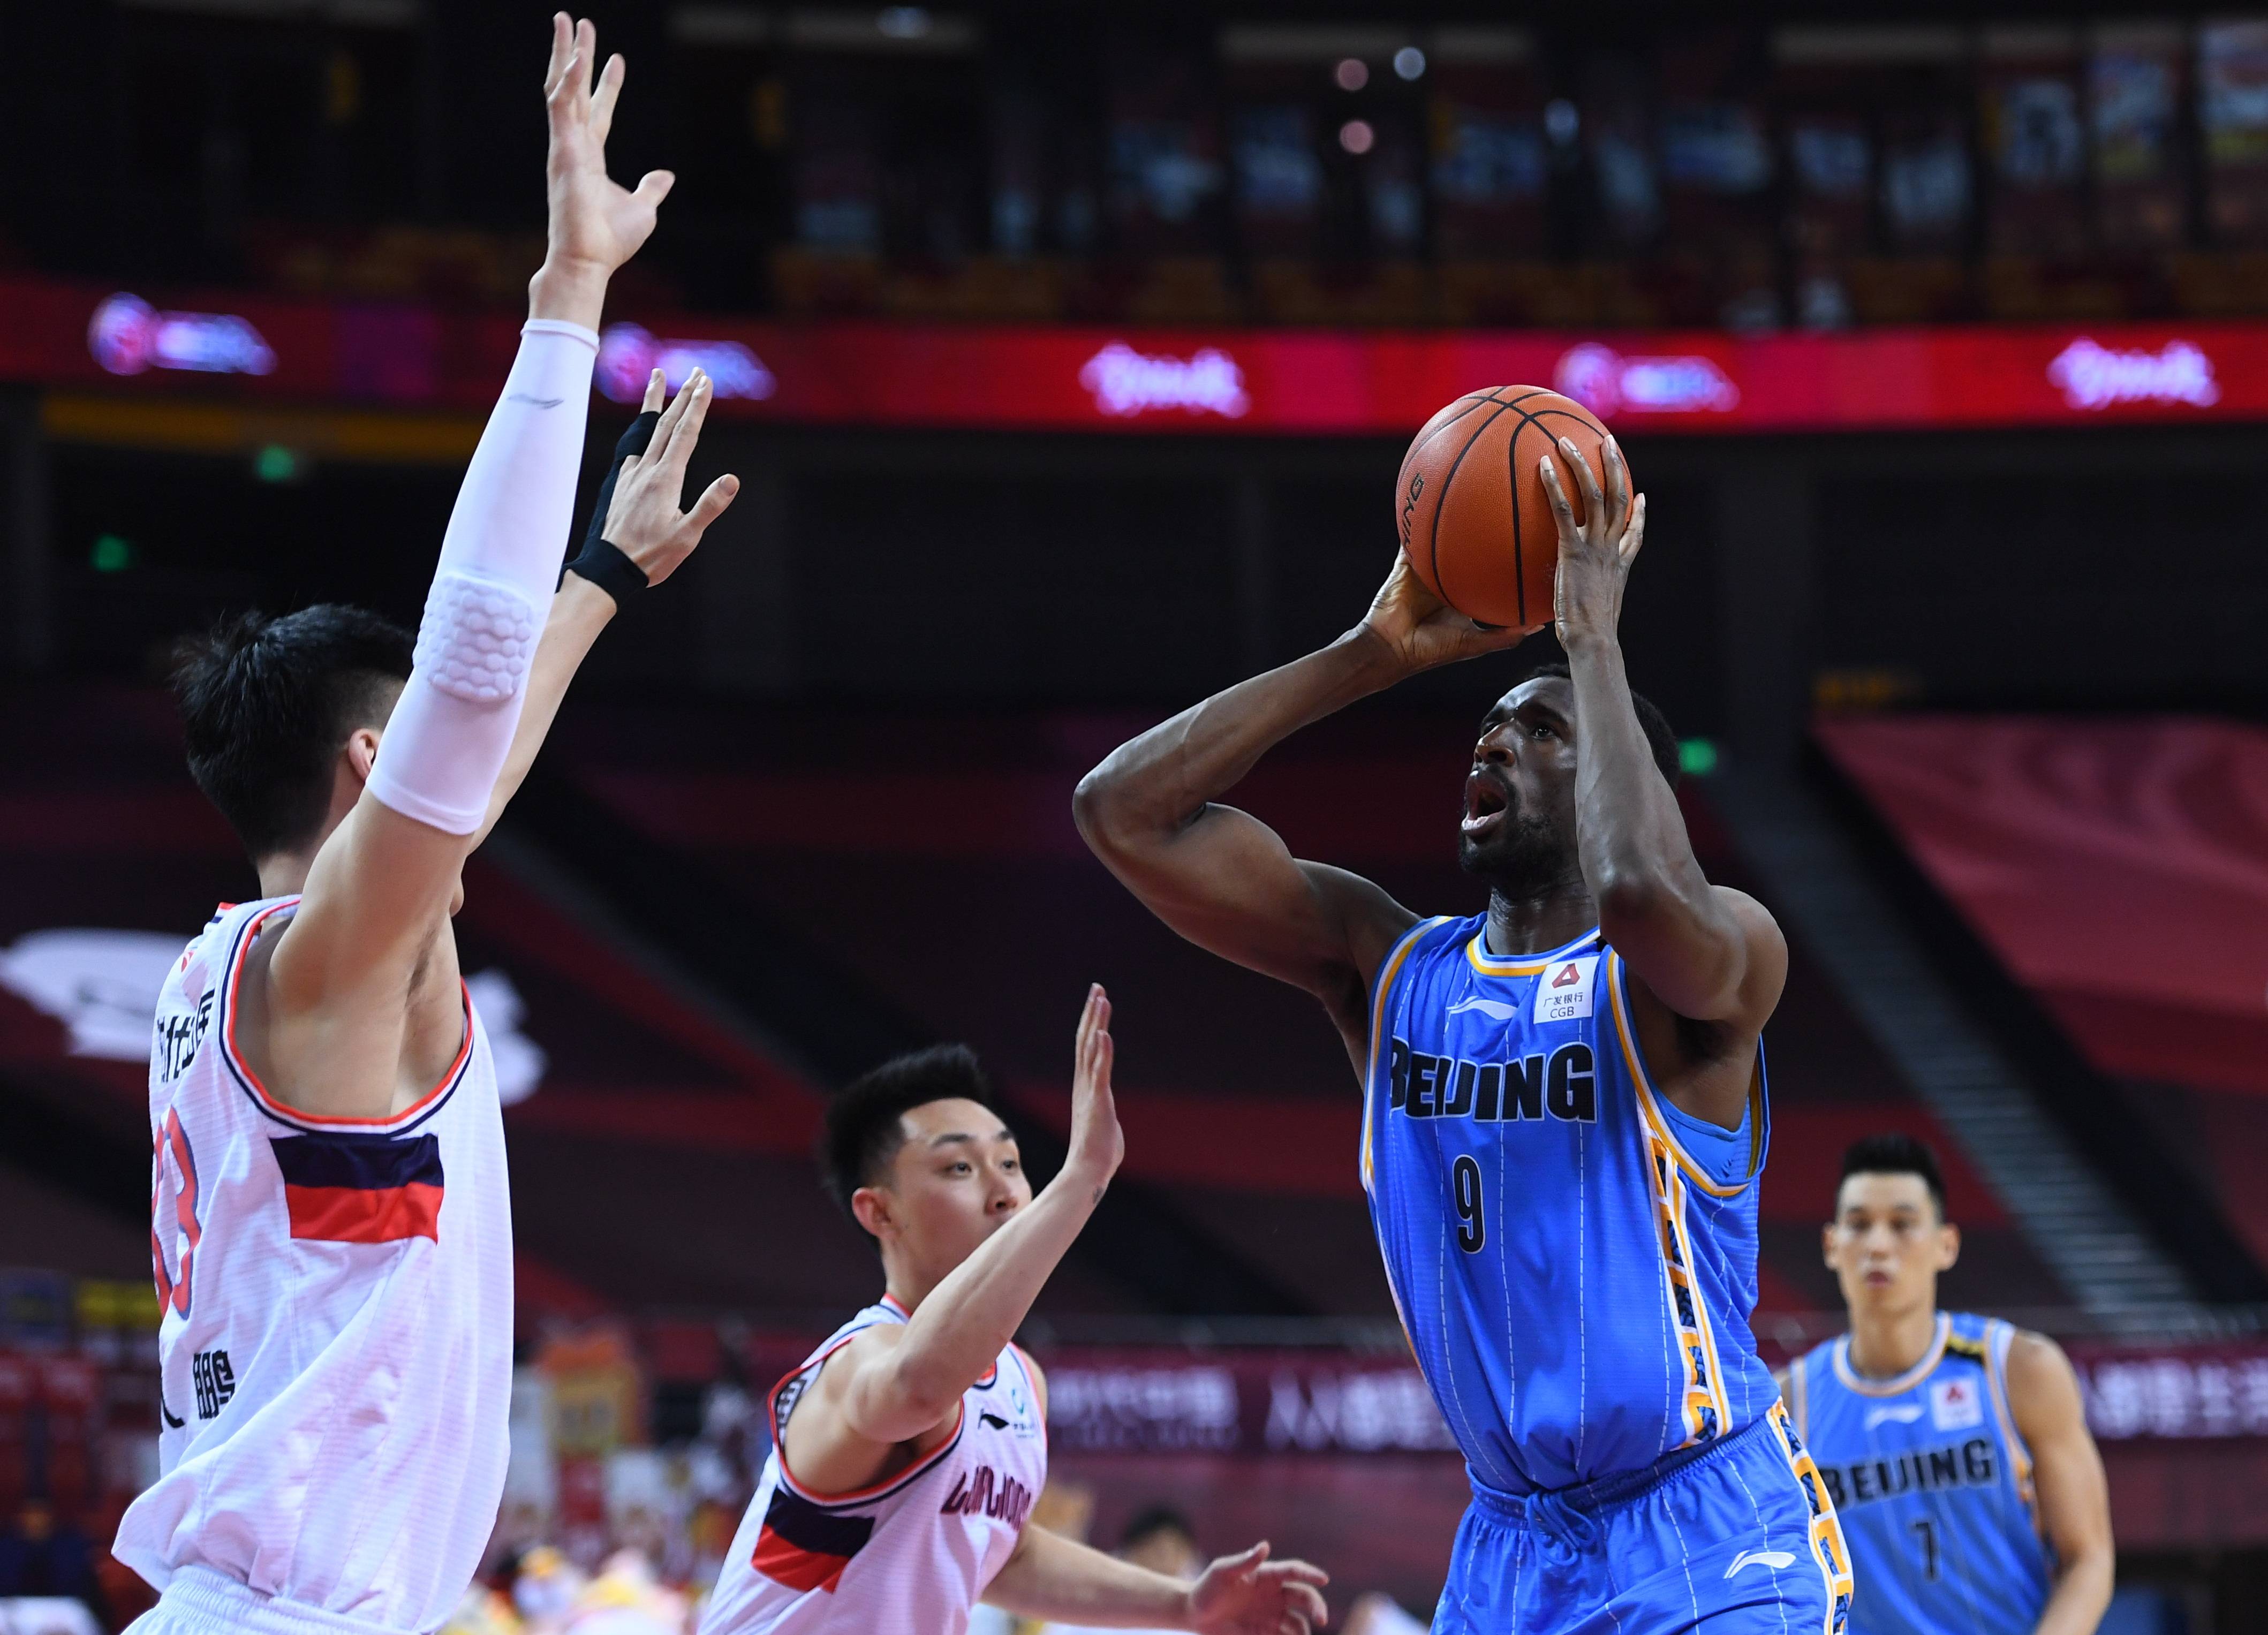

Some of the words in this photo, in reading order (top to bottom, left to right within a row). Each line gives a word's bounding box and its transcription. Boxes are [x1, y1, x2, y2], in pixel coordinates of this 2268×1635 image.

[1544, 992, 1583, 1008] 广发银行
[1549, 1006, 1575, 1019] CGB
[1453, 1154, 1485, 1254] 9
[1911, 1519, 1938, 1581] 7
